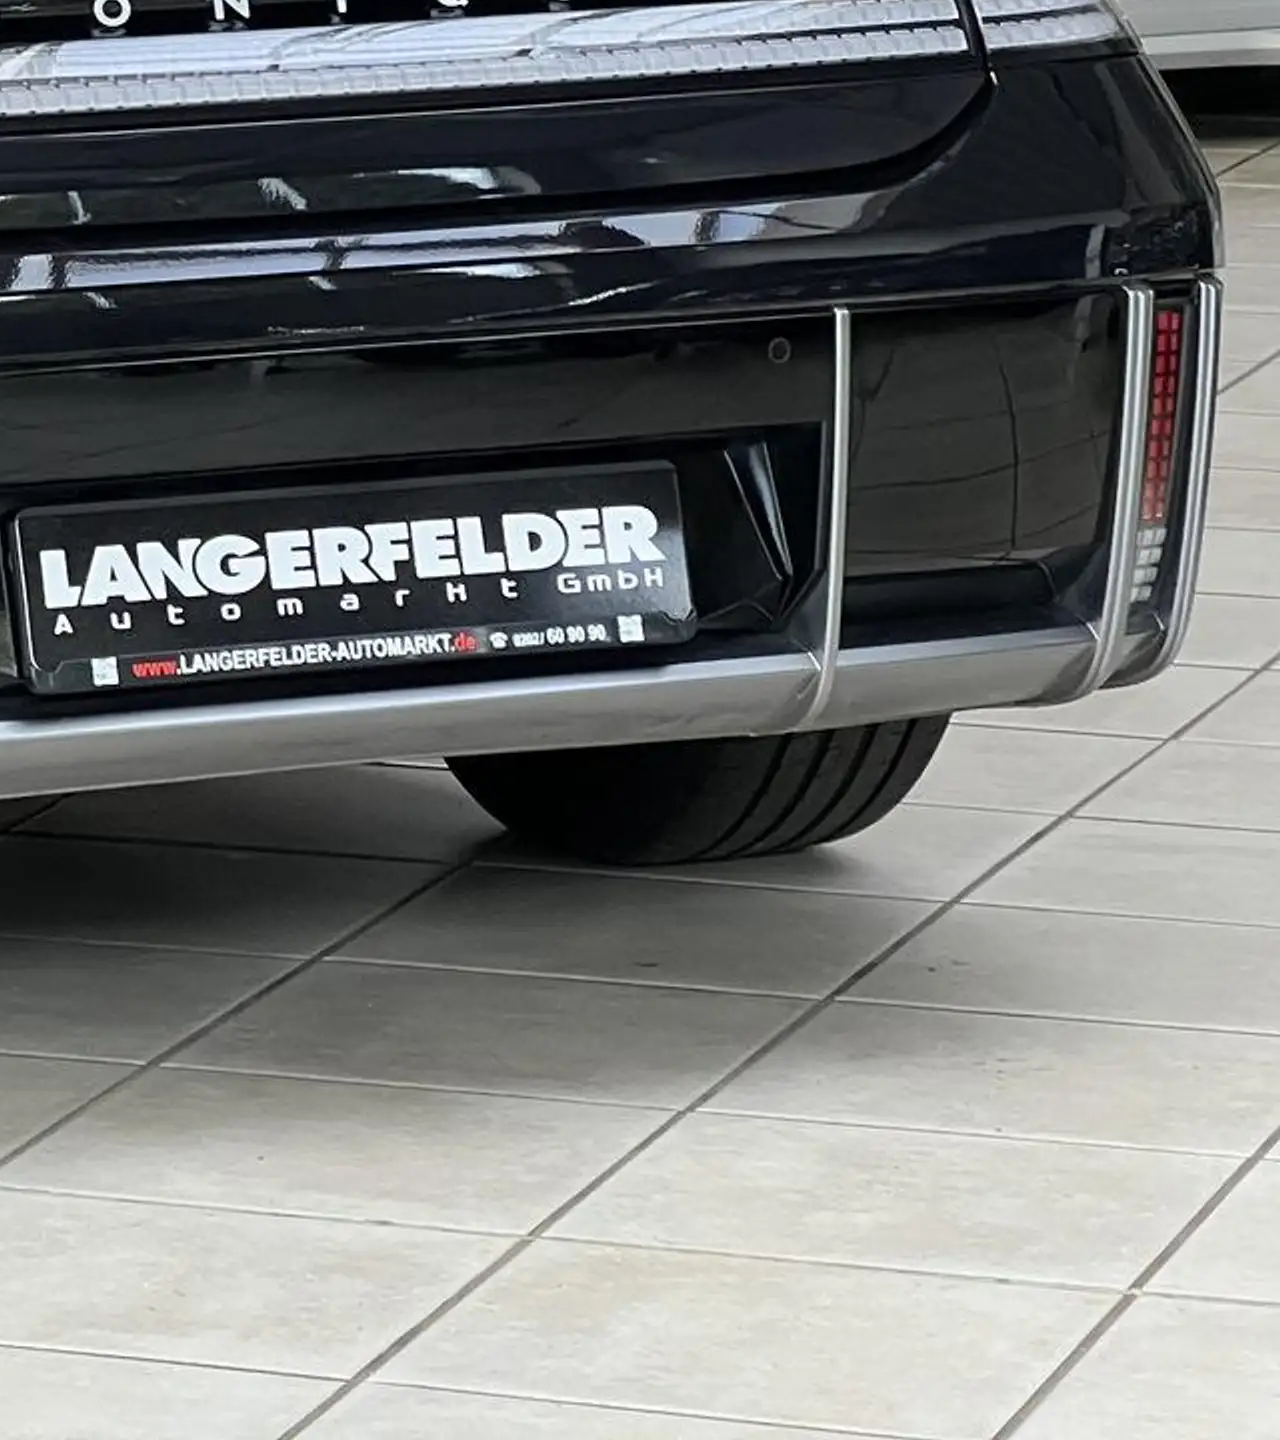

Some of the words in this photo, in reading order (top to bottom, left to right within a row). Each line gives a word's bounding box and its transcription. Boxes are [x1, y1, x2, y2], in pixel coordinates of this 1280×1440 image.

[39, 505, 667, 610] LANGERFELDER
[556, 567, 665, 594] GmbH
[131, 629, 478, 678] www.LANGERFELDER-AUTOMARKT.de
